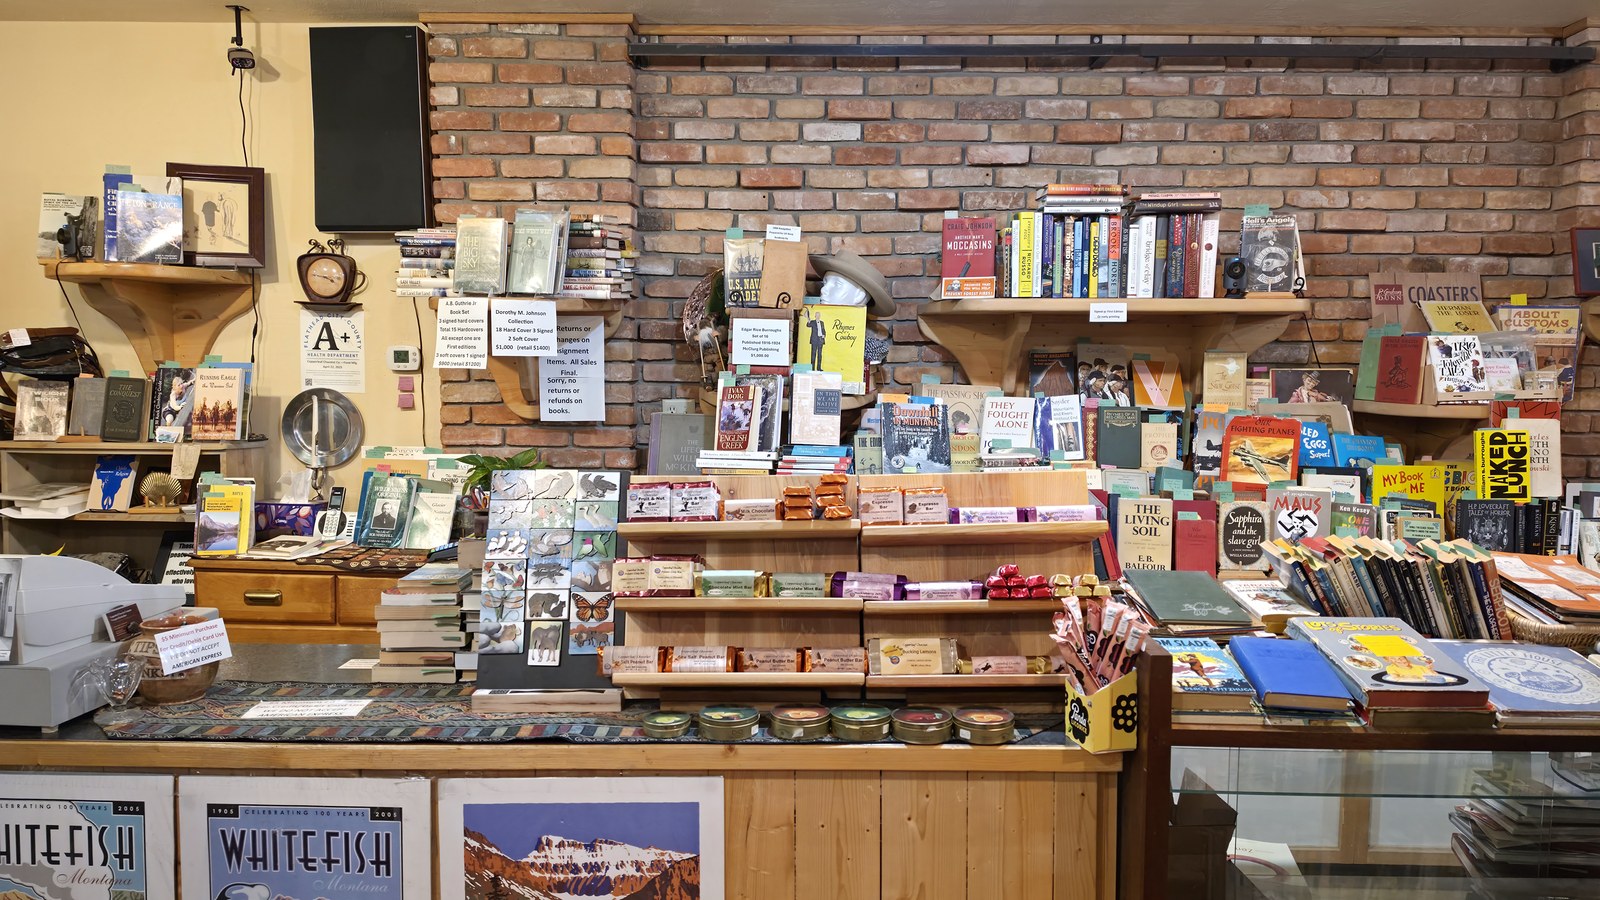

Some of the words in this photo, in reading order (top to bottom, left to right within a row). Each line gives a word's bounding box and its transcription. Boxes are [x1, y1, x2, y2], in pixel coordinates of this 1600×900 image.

[1266, 216, 1296, 225] Angels
[947, 222, 964, 231] CRAIG
[966, 222, 993, 231] JOHNSON
[463, 236, 478, 247] THE
[946, 240, 992, 250] MOCCASINS
[463, 247, 478, 258] BIG
[462, 259, 476, 268] SKY
[1408, 286, 1479, 303] COASTERS
[1514, 310, 1560, 318] ABOUT
[832, 319, 856, 331] Rhymes
[1504, 320, 1569, 328] CUSTOMS
[304, 314, 324, 348] FLATHEAD
[312, 322, 350, 350] A+
[834, 332, 858, 348] Cowboy
[1454, 341, 1476, 351] TRIO
[118, 384, 132, 392] THE
[110, 390, 142, 400] CONQUEST
[927, 388, 941, 398] THE
[942, 390, 972, 400] PASSING
[894, 404, 938, 418] Downhill
[990, 402, 1015, 410] THEY
[986, 410, 1030, 420] FOUGHT
[902, 418, 938, 427] MONTANA
[994, 420, 1028, 429] ALONE
[1230, 425, 1266, 434] FIGHTING
[1268, 426, 1295, 436] PLANES
[1302, 438, 1328, 450] EGGS
[1310, 449, 1331, 459] Super!
[1489, 432, 1508, 498] NAKED
[1508, 432, 1528, 498] LUNCH
[1382, 474, 1397, 488] MY
[1410, 482, 1425, 494] ME
[1134, 504, 1161, 515] THE
[1274, 496, 1322, 514] MAUS
[1352, 506, 1370, 514] Kesey
[1125, 514, 1170, 526] LIVING
[1228, 511, 1262, 529] Sapphira
[1348, 516, 1370, 525] ONE
[1132, 526, 1160, 537] SOIL
[1232, 526, 1247, 535] and
[1248, 525, 1257, 535] the
[1228, 536, 1246, 547] slave
[1246, 536, 1260, 550] girl
[1125, 562, 1166, 570] BALFOUR
[168, 630, 195, 640] Minimum
[195, 624, 218, 634] Purchase
[170, 638, 202, 650] Credit/Debit
[189, 648, 200, 656] NOT
[201, 642, 220, 652] ACCEPT
[1174, 640, 1211, 648] SLADE
[172, 659, 201, 670] AMERICAN
[201, 652, 222, 661] EXPRESS
[0, 824, 136, 870] HITEFISH
[218, 828, 392, 878] WHITEFISH
[56, 868, 133, 885] Montana
[312, 874, 390, 894] Montana
